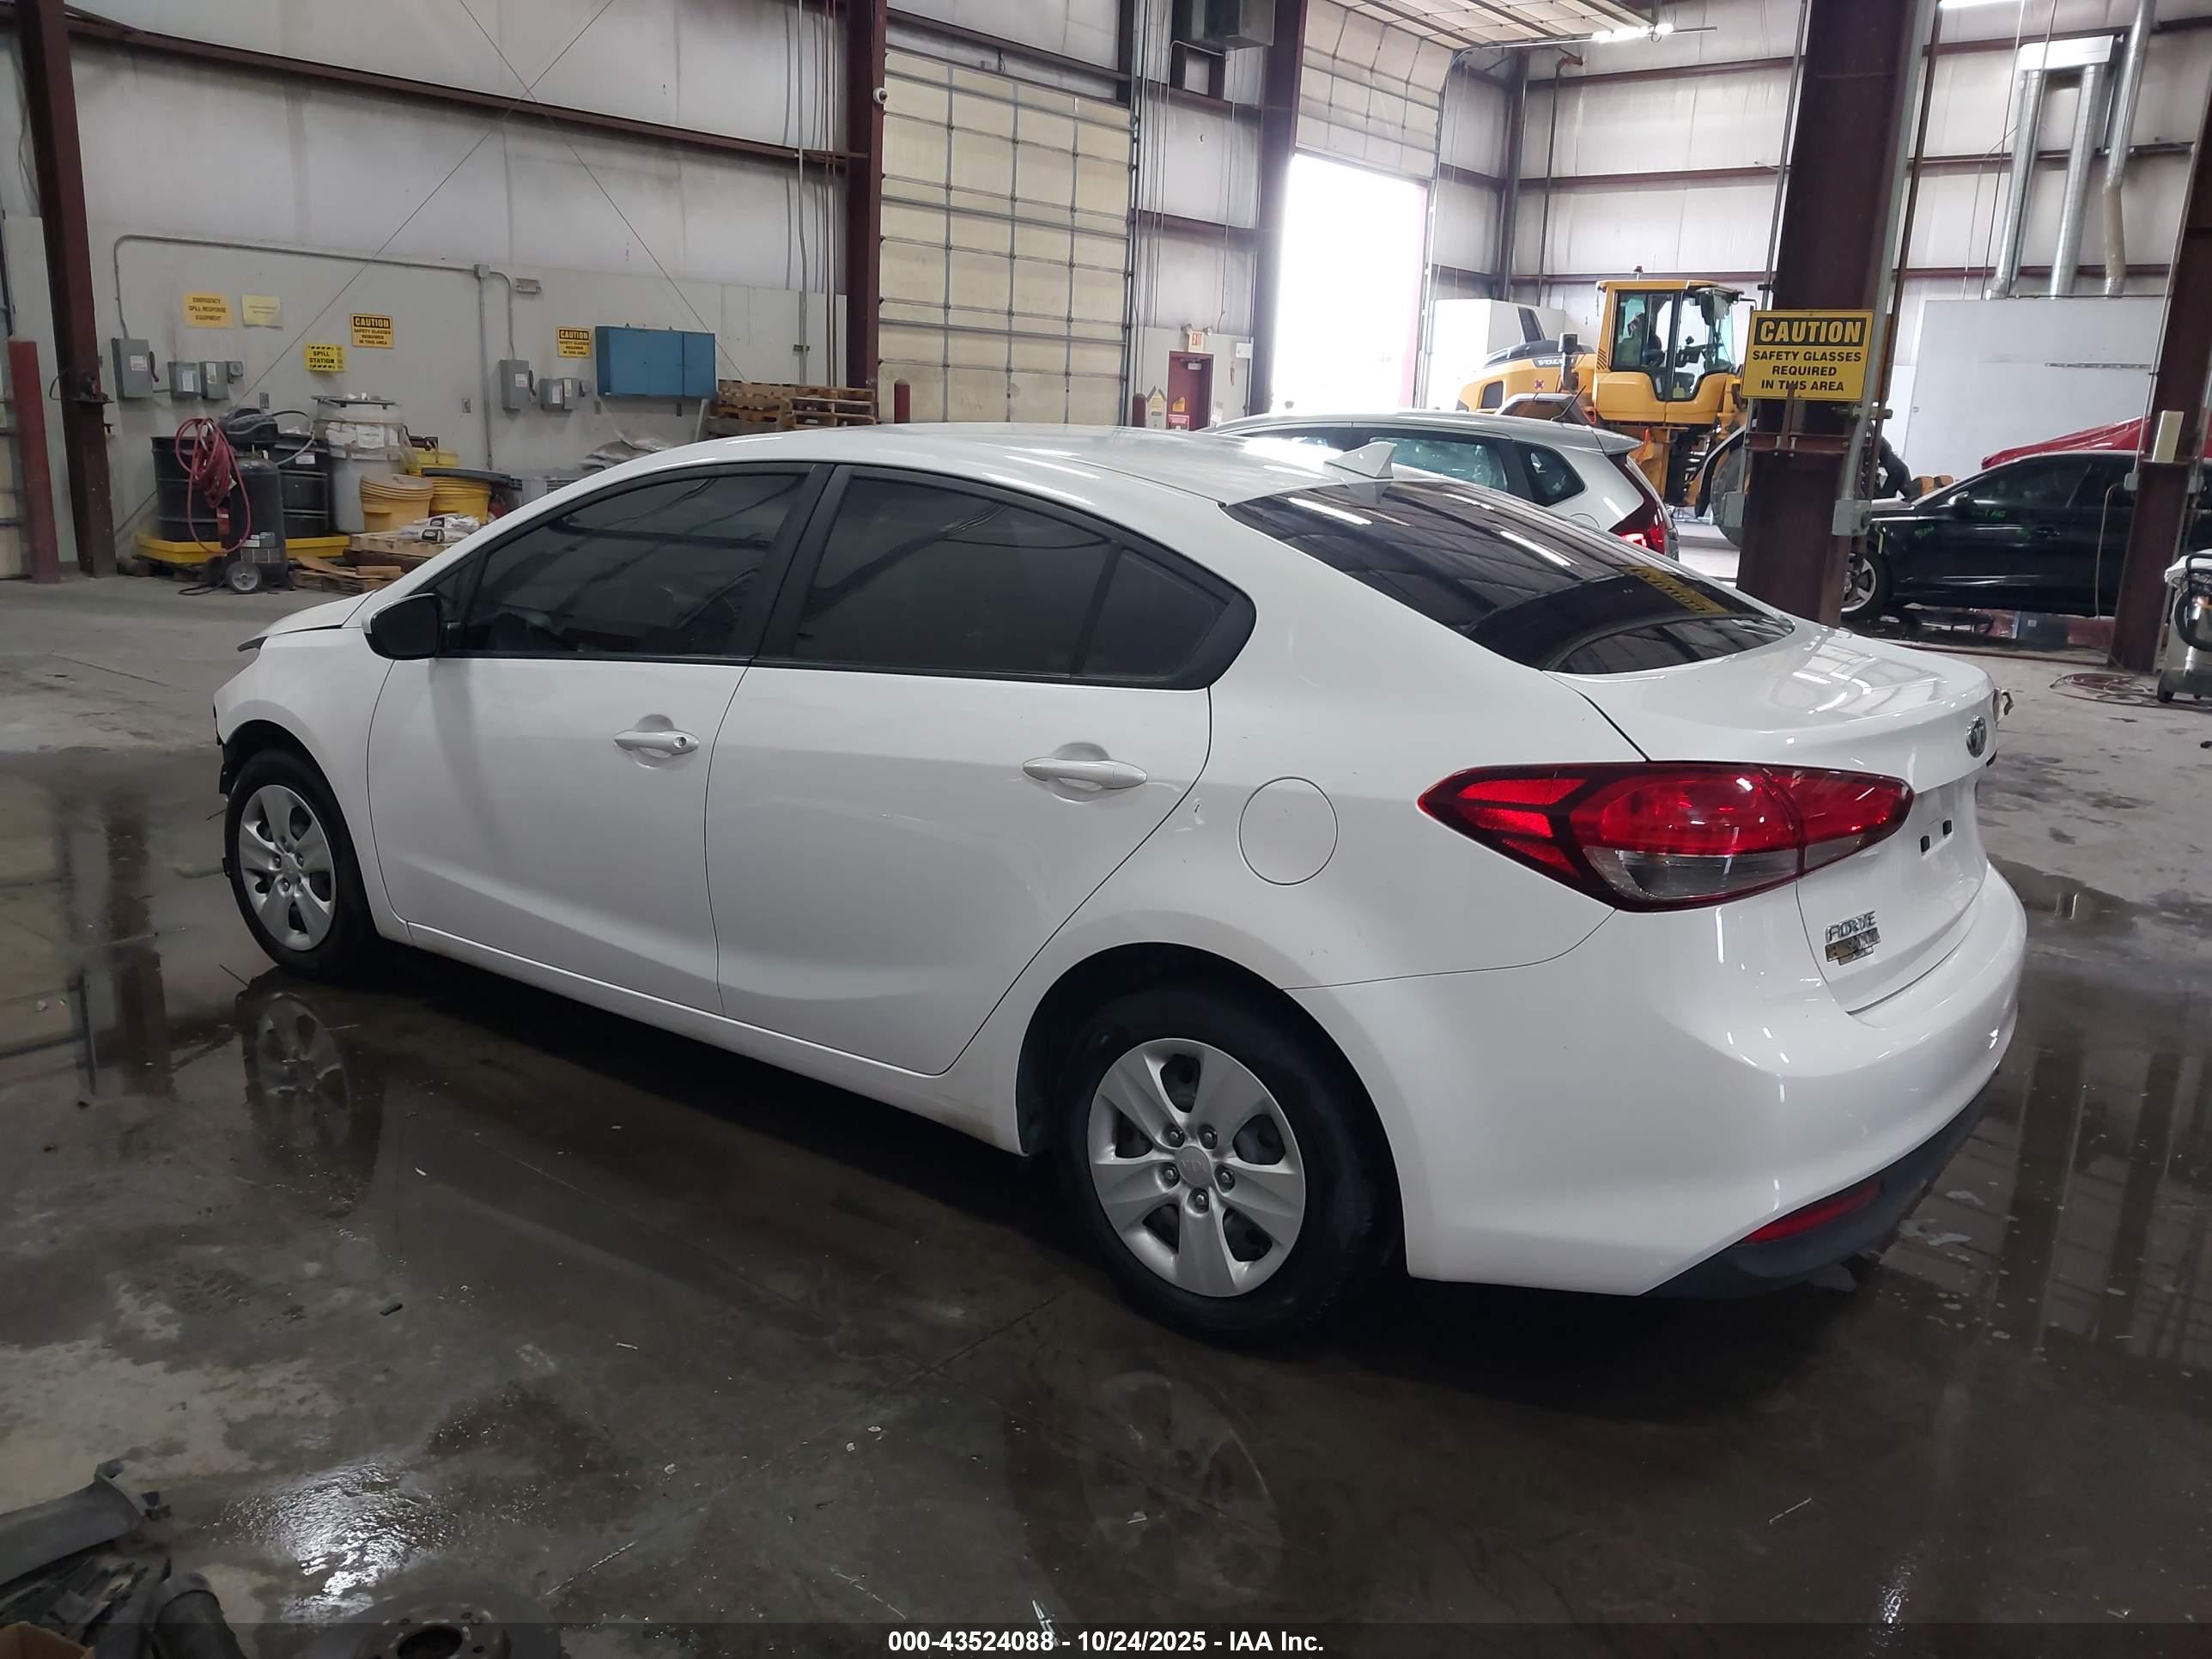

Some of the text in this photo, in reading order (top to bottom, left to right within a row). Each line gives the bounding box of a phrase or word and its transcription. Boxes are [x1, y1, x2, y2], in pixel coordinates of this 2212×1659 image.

[355, 318, 389, 328] CAUTION
[560, 331, 588, 339] CAUTION
[1760, 320, 1862, 343] CAUTION
[1753, 350, 1862, 362] SAFETY GLASSES
[1771, 365, 1837, 376] REQUIRED
[1760, 379, 1774, 390] IN
[1810, 380, 1844, 392] AREA
